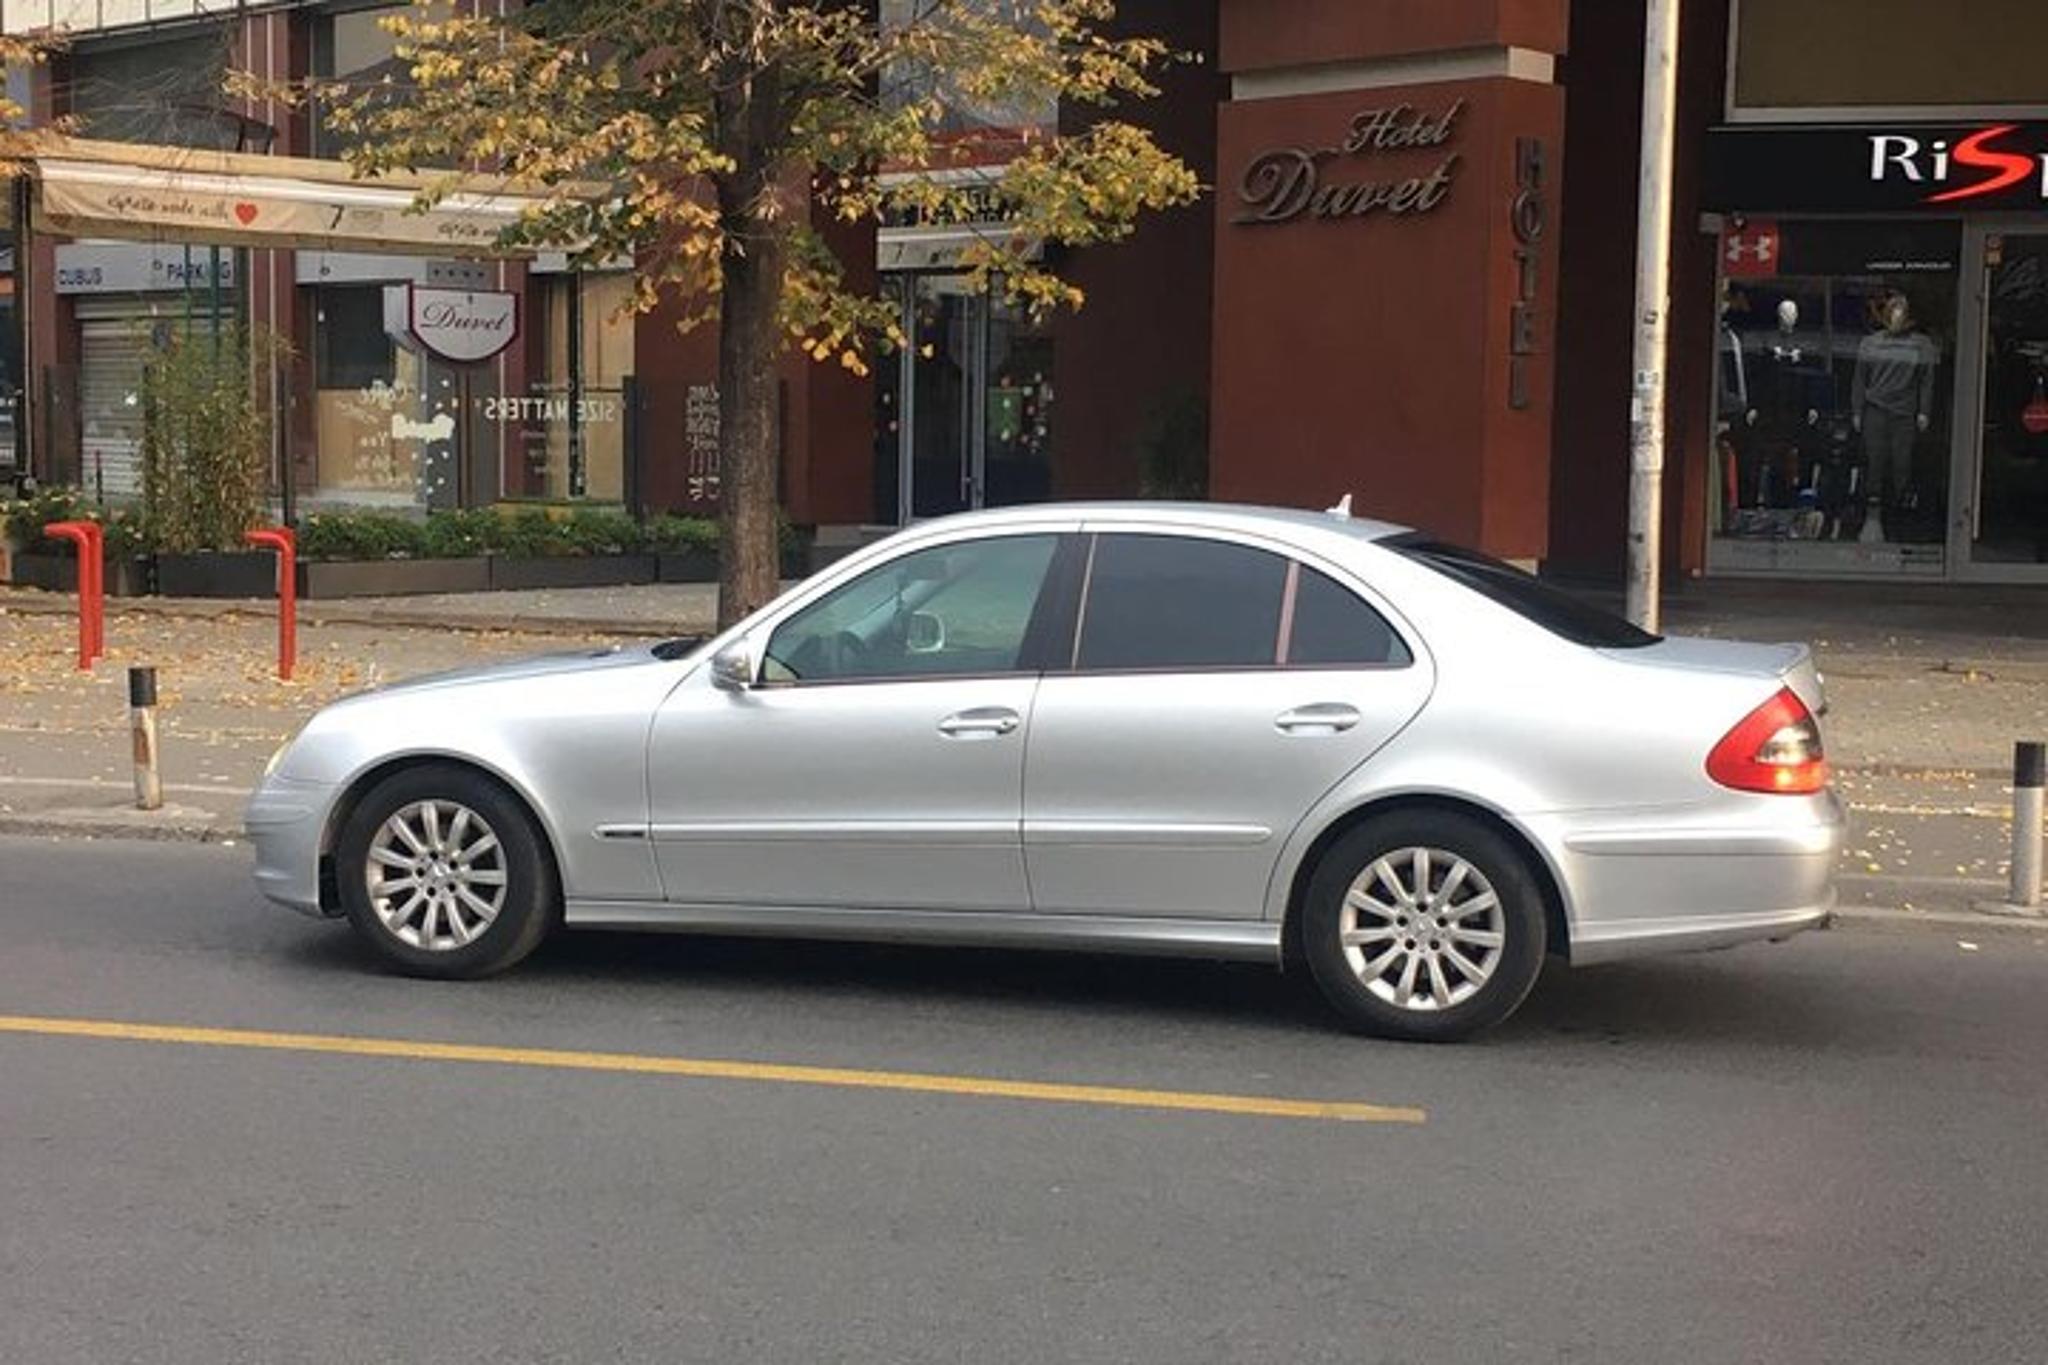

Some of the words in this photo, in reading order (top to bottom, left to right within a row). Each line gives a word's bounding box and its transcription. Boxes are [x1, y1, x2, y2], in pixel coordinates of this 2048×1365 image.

[1344, 98, 1463, 152] Hotel
[1867, 124, 2048, 201] RiS
[1230, 148, 1463, 224] Duvet
[167, 260, 231, 282] PARKG
[1508, 136, 1548, 410] HOTEL
